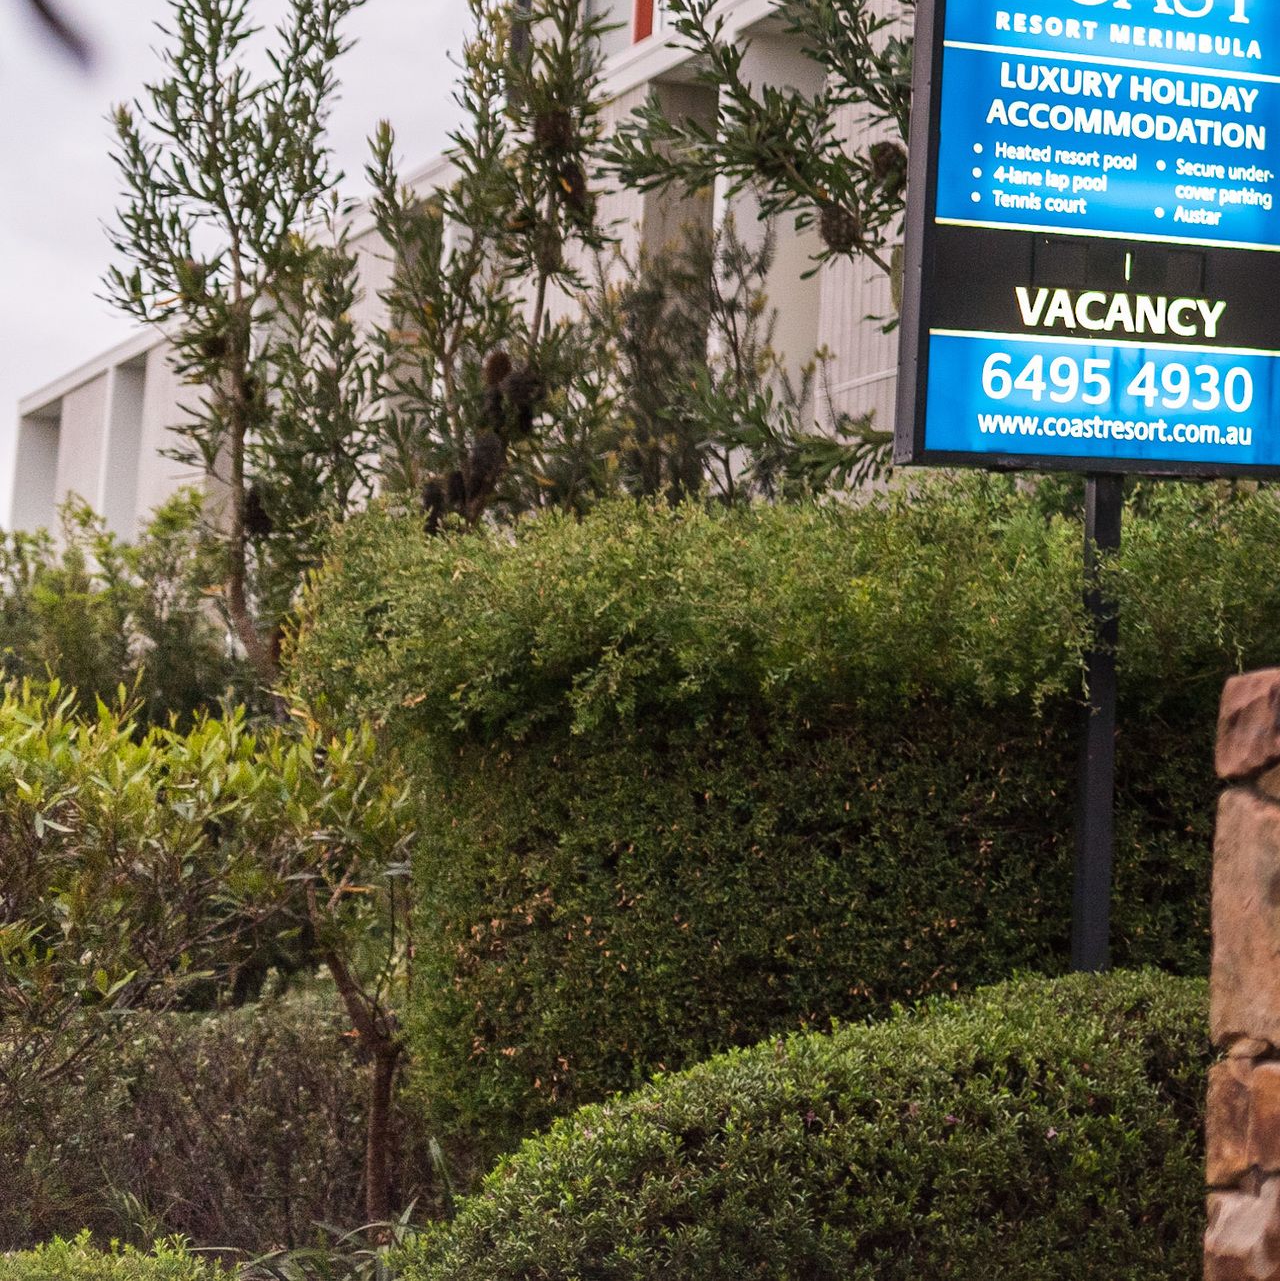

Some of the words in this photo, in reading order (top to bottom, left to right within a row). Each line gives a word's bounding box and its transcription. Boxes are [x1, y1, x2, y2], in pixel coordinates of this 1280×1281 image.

[995, 11, 1098, 41] RESORT
[1110, 24, 1262, 60] MERIMBULA
[1000, 62, 1122, 99] LUXURY
[1130, 75, 1259, 113] HOLIDAY
[986, 99, 1266, 151] ACCOMMODATION
[995, 141, 1050, 163] Heated
[1055, 149, 1100, 168] resort
[1103, 153, 1137, 172] pool
[1175, 158, 1225, 179] Secure
[1228, 165, 1275, 183] under-
[993, 165, 1042, 186] 4-lane
[1045, 169, 1070, 192] lap
[1072, 174, 1107, 193] pool
[992, 189, 1041, 211] Tennis
[1044, 197, 1087, 214] court
[1174, 184, 1217, 202] cover
[1219, 187, 1273, 210] parking
[1173, 205, 1222, 226] Austar
[1014, 286, 1226, 337] VACANCY
[981, 352, 1111, 406] 6495
[1127, 361, 1253, 413] 4930
[977, 412, 1253, 447] www.coastresort.com.au
